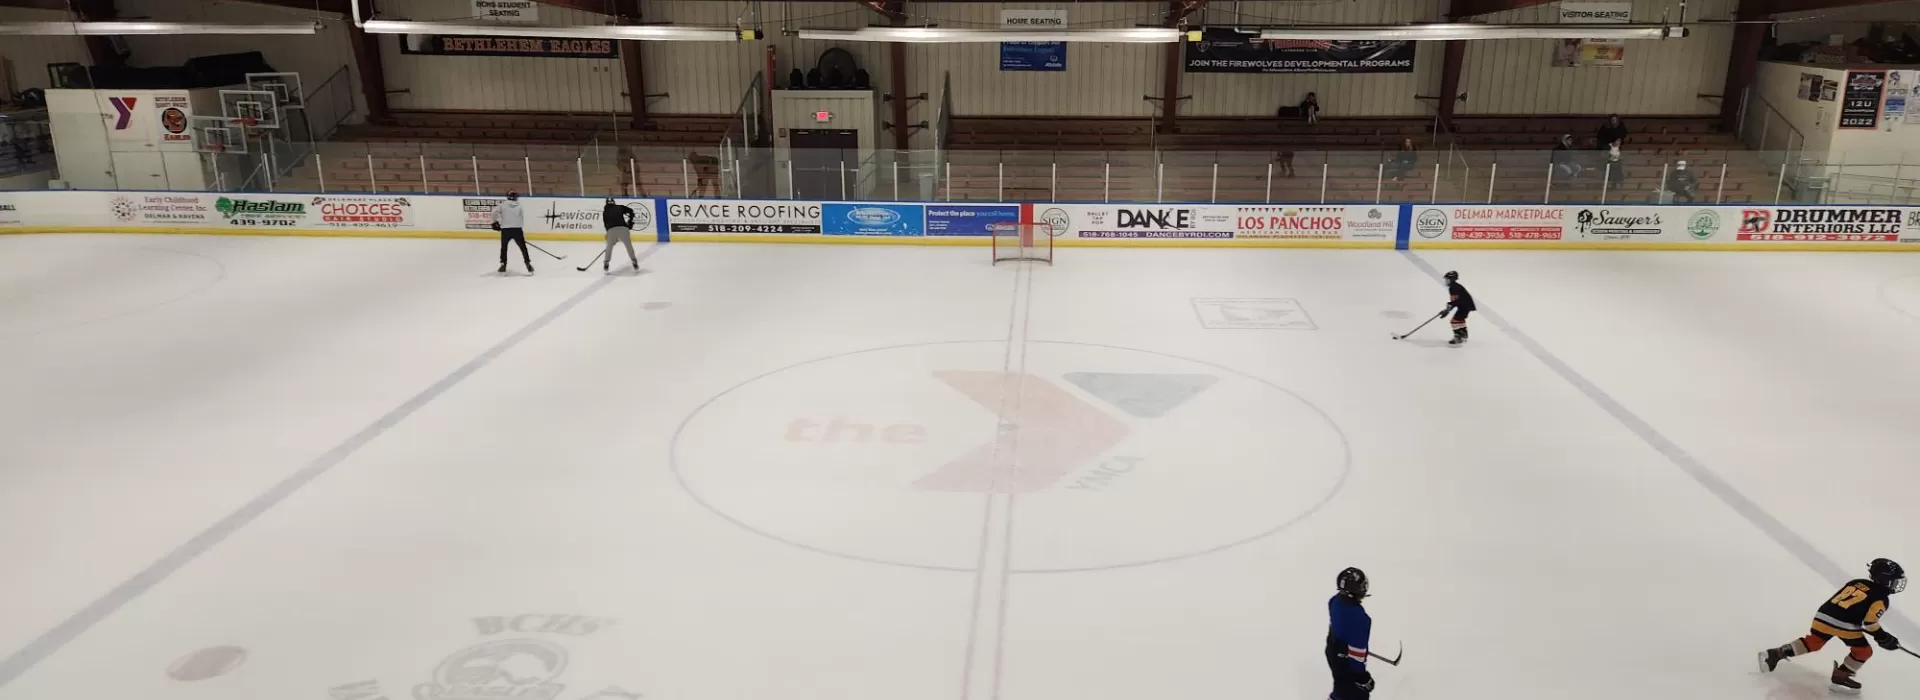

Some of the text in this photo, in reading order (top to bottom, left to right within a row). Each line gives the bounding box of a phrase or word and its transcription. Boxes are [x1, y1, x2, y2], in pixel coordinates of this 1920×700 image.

[444, 38, 611, 53] BETHLEHEM EAGLES
[144, 196, 199, 204] Early Childhood
[231, 199, 305, 214] Haslam
[321, 203, 402, 215] CHOICES
[669, 204, 821, 218] GRACE ROOFING
[928, 210, 950, 218] Protect
[950, 210, 959, 218] the
[960, 210, 975, 219] place
[976, 211, 986, 219] you
[1117, 208, 1189, 229] DANCE
[1454, 209, 1564, 220] DELMAR MARKETPLACE
[1592, 209, 1661, 228] Sawyer's
[1774, 209, 1902, 223] DRUMMER
[554, 222, 593, 230] Aviation
[1042, 217, 1066, 225] SIGN
[1237, 217, 1265, 229] LOS
[1269, 217, 1342, 230] PANCHOS
[1347, 220, 1394, 228] Woodland Hill
[1419, 218, 1445, 226] SIGN
[708, 225, 784, 233] 518-209-4224
[1773, 223, 1900, 233] INTERIORS LLC
[783, 417, 928, 444] the
[1064, 456, 1145, 493] YMCA
